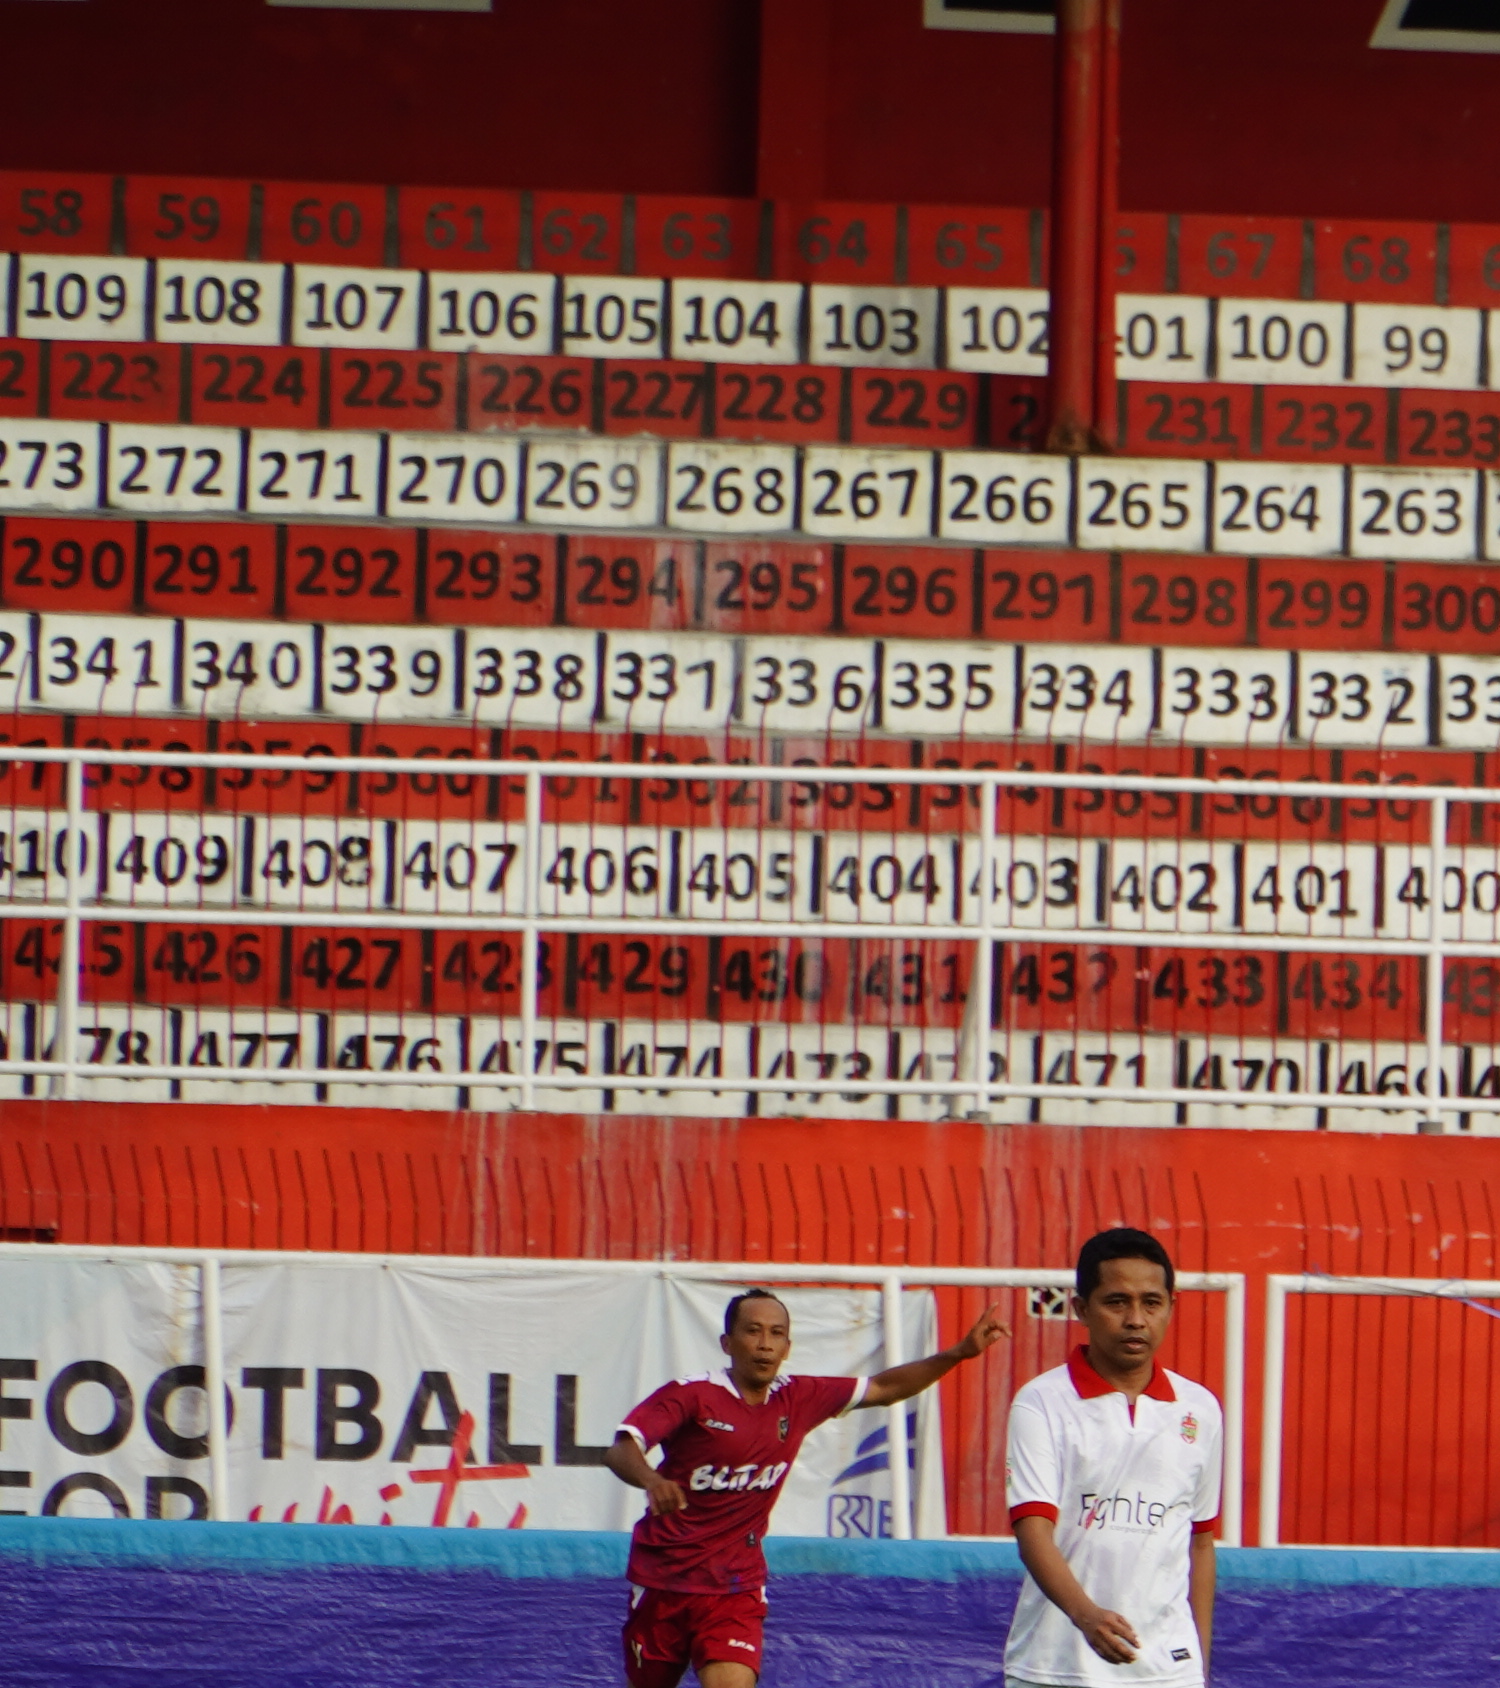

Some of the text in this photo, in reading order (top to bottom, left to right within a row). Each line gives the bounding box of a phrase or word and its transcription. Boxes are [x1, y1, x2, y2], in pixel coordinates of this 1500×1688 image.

[25, 271, 125, 322] 109
[164, 276, 260, 325] 108
[306, 283, 403, 331] 107
[439, 290, 536, 339] 106
[564, 295, 660, 346] 105
[684, 296, 779, 346] 104
[827, 304, 919, 355] 103
[961, 305, 1048, 356] 102
[1232, 314, 1328, 367] 100
[1384, 325, 1447, 372] 99
[482, 365, 581, 416] 226
[723, 373, 824, 423] 228
[120, 446, 221, 495] 272
[259, 449, 360, 500] 271
[399, 455, 505, 505] 270
[534, 461, 638, 509] 269
[676, 465, 784, 515] 268
[813, 468, 917, 518] 267
[950, 474, 1052, 524] 266
[1088, 479, 1188, 529] 265
[1221, 484, 1318, 532] 264
[1361, 488, 1460, 535] 263
[13, 537, 124, 589] 290
[153, 544, 257, 594] 291
[296, 546, 400, 596] 292
[853, 566, 955, 615] 296
[1268, 580, 1369, 628] 299
[49, 636, 158, 688] 341
[192, 641, 300, 691] 340
[331, 645, 441, 696] 339
[473, 647, 583, 702] 338
[753, 656, 863, 712] 336
[890, 662, 993, 710] 335
[1030, 663, 1132, 715] 334
[1172, 667, 1277, 721] 333
[1309, 671, 1413, 723] 332
[115, 835, 229, 886] 409
[403, 841, 517, 893] 407
[545, 845, 658, 895] 406
[687, 853, 794, 902] 405
[827, 854, 939, 905] 404
[1109, 862, 1217, 913] 402
[1252, 864, 1356, 918] 401
[0, 1359, 612, 1465] FOOTBALL
